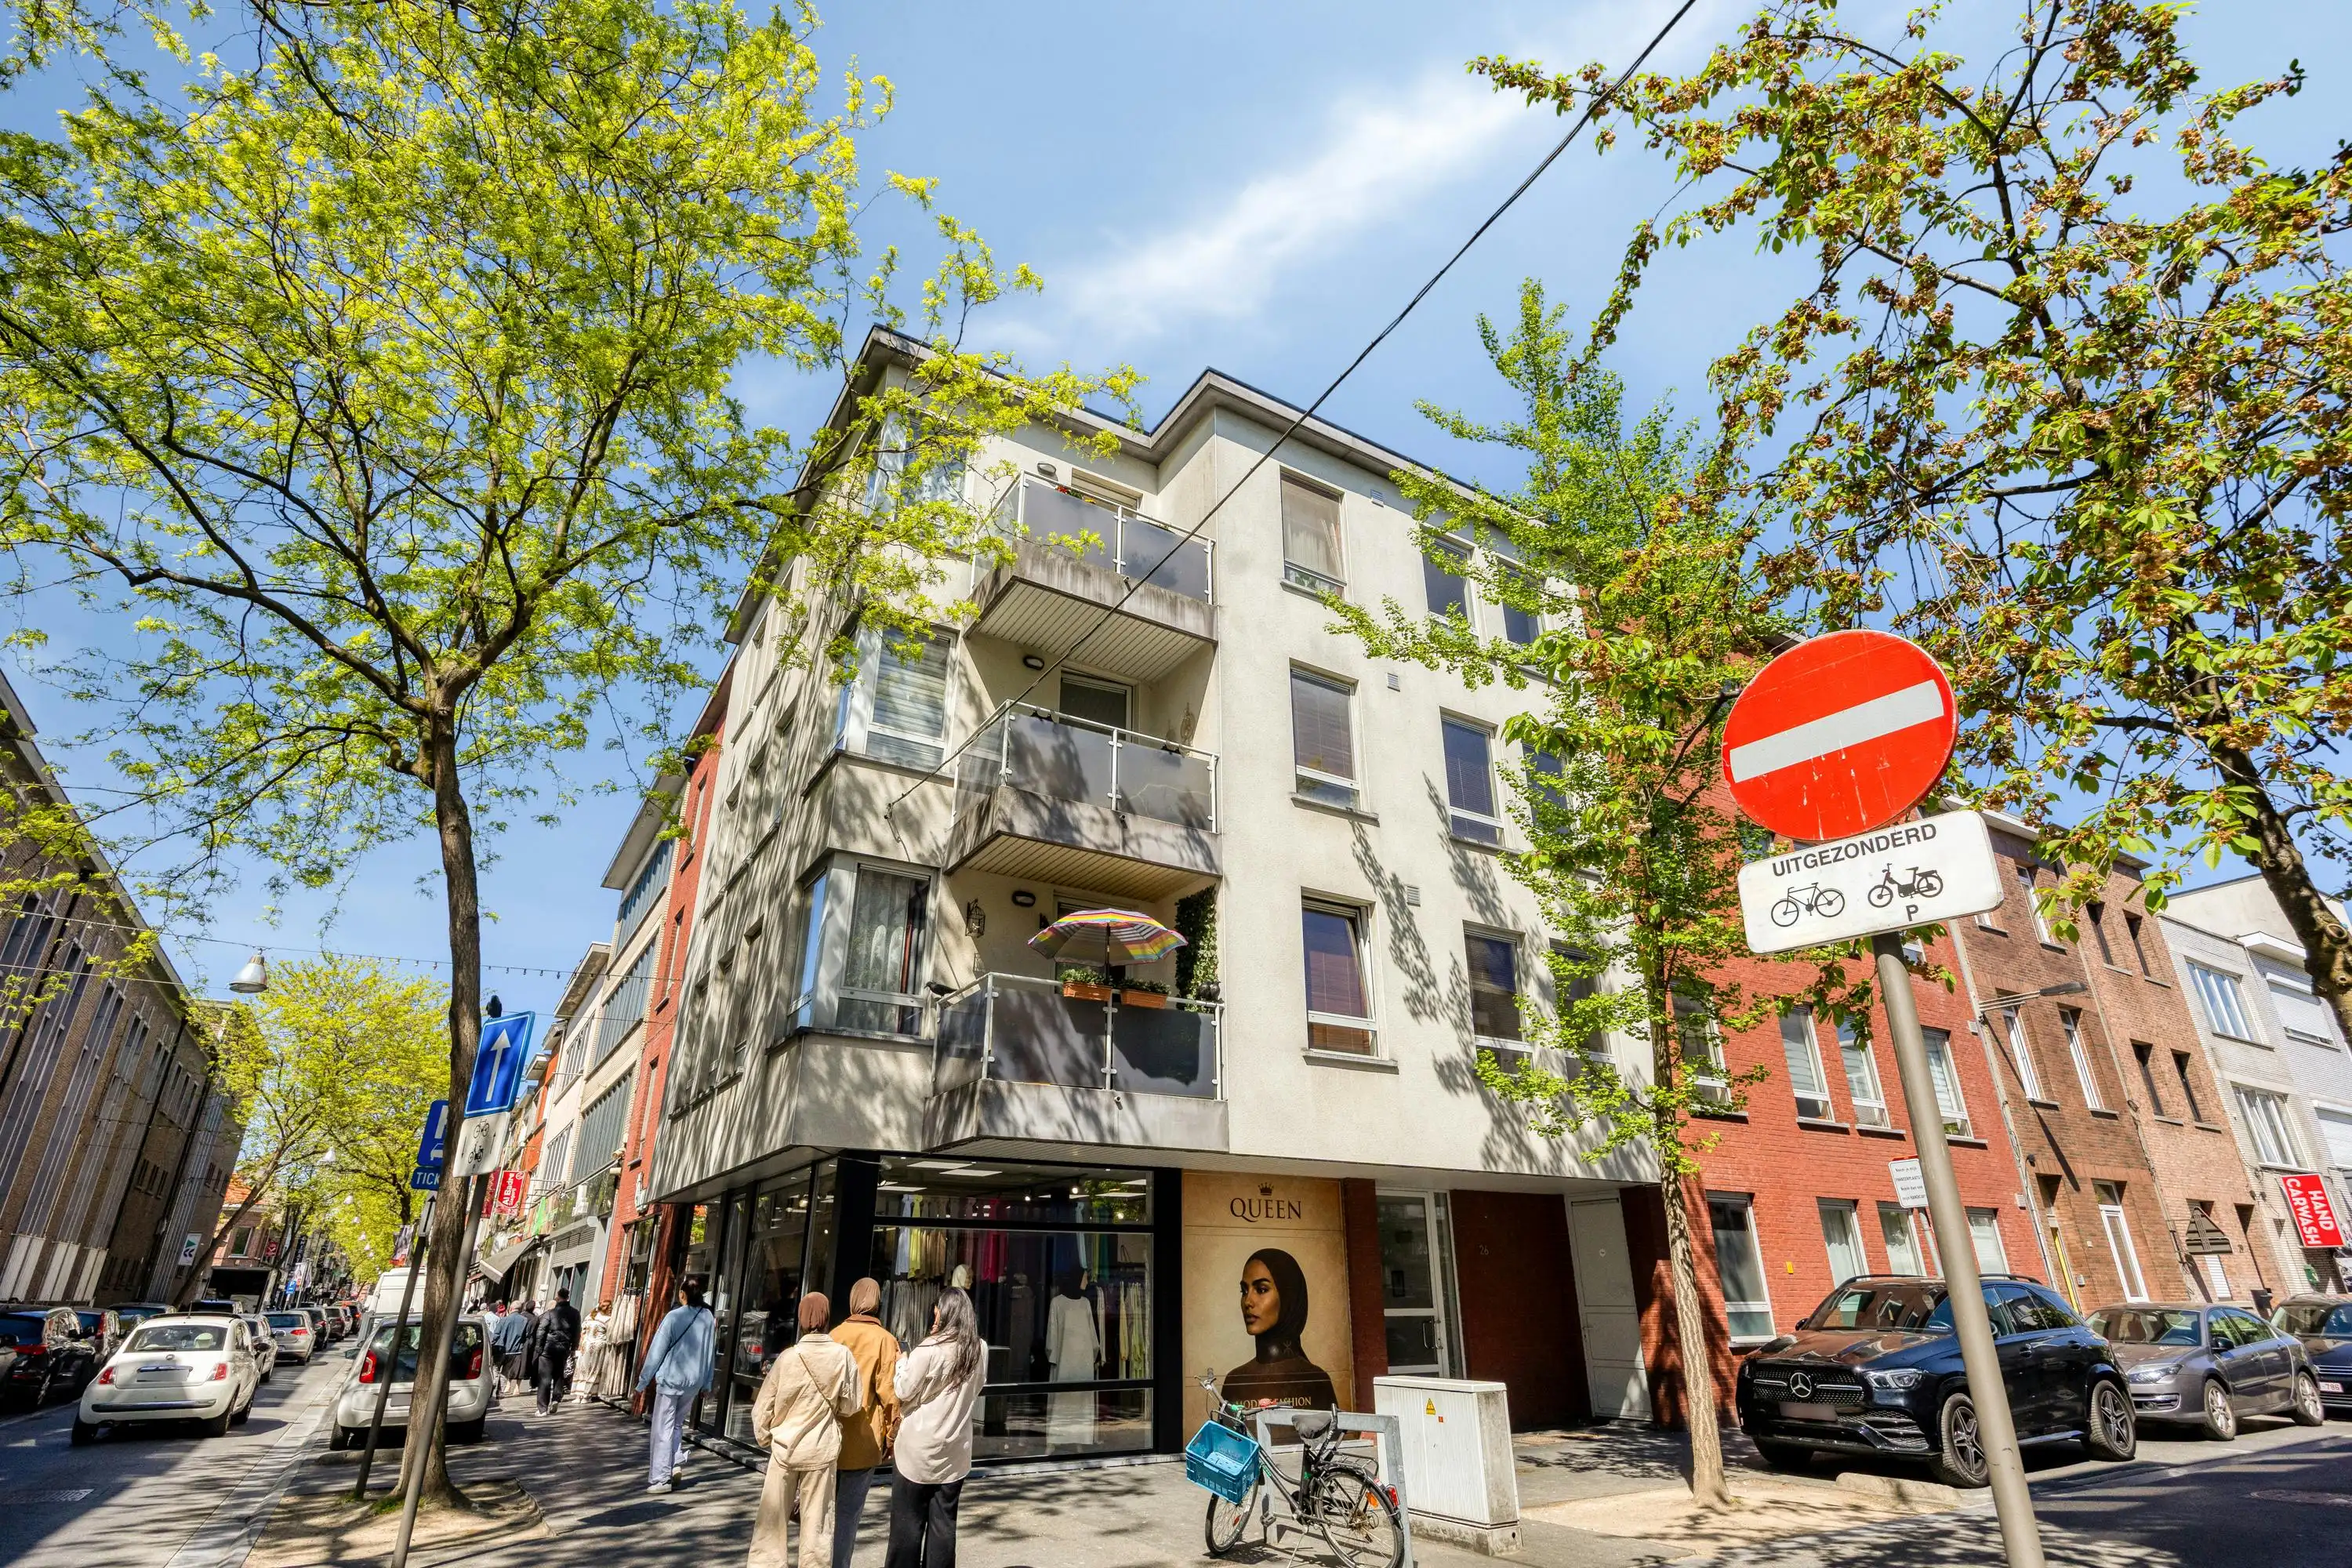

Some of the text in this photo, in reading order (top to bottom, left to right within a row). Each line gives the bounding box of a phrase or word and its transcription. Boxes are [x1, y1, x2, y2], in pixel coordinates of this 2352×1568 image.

[1772, 822, 1937, 877] UITGEZONDERD
[1906, 904, 1919, 921] P
[1229, 1197, 1301, 1222] QUEEN
[2286, 1178, 2322, 1245] CARWASH
[2308, 1190, 2334, 1231] HAND
